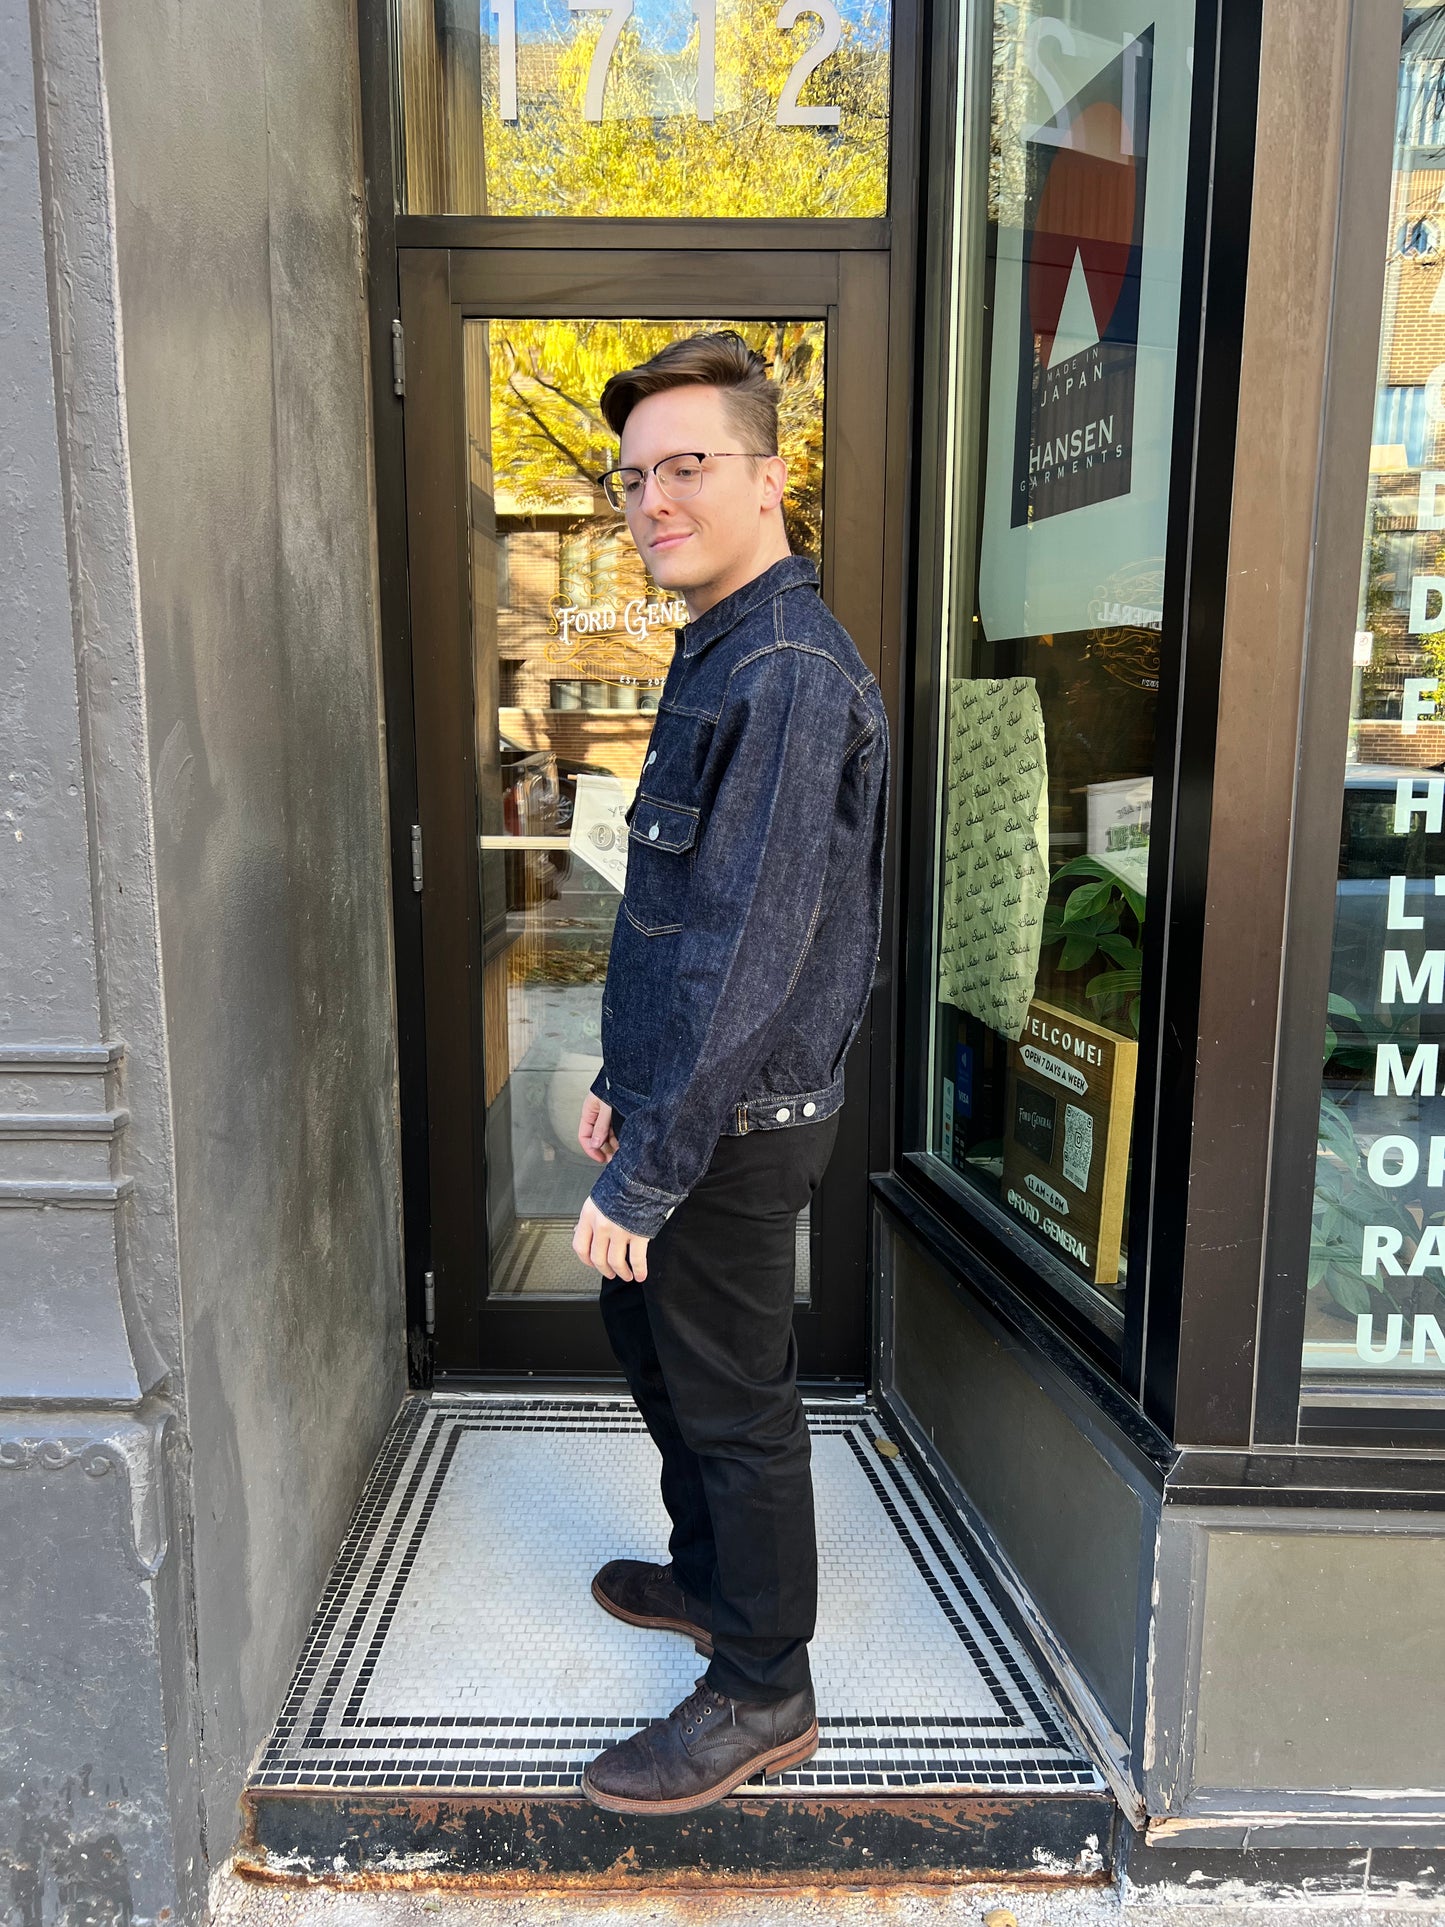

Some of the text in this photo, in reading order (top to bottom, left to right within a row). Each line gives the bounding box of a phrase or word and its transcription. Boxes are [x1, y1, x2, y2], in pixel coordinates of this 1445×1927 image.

[490, 0, 841, 126] 1712
[1040, 362, 1103, 408] JAPAN
[1047, 347, 1098, 382] MADE IN
[1029, 415, 1114, 474] HANSEN
[1020, 444, 1123, 492] GARMENTS
[556, 598, 691, 646] FORD GENE
[619, 675, 666, 687] EST. 202
[607, 805, 630, 818] YE
[1024, 1049, 1085, 1091] OPEN 7 DAYS A WEEK
[1028, 1177, 1034, 1189] 11
[1035, 1183, 1046, 1198] AM
[1049, 1192, 1054, 1204] 6
[1054, 1195, 1065, 1212] PM
[1007, 1188, 1090, 1268] @FORD_GENERAL
